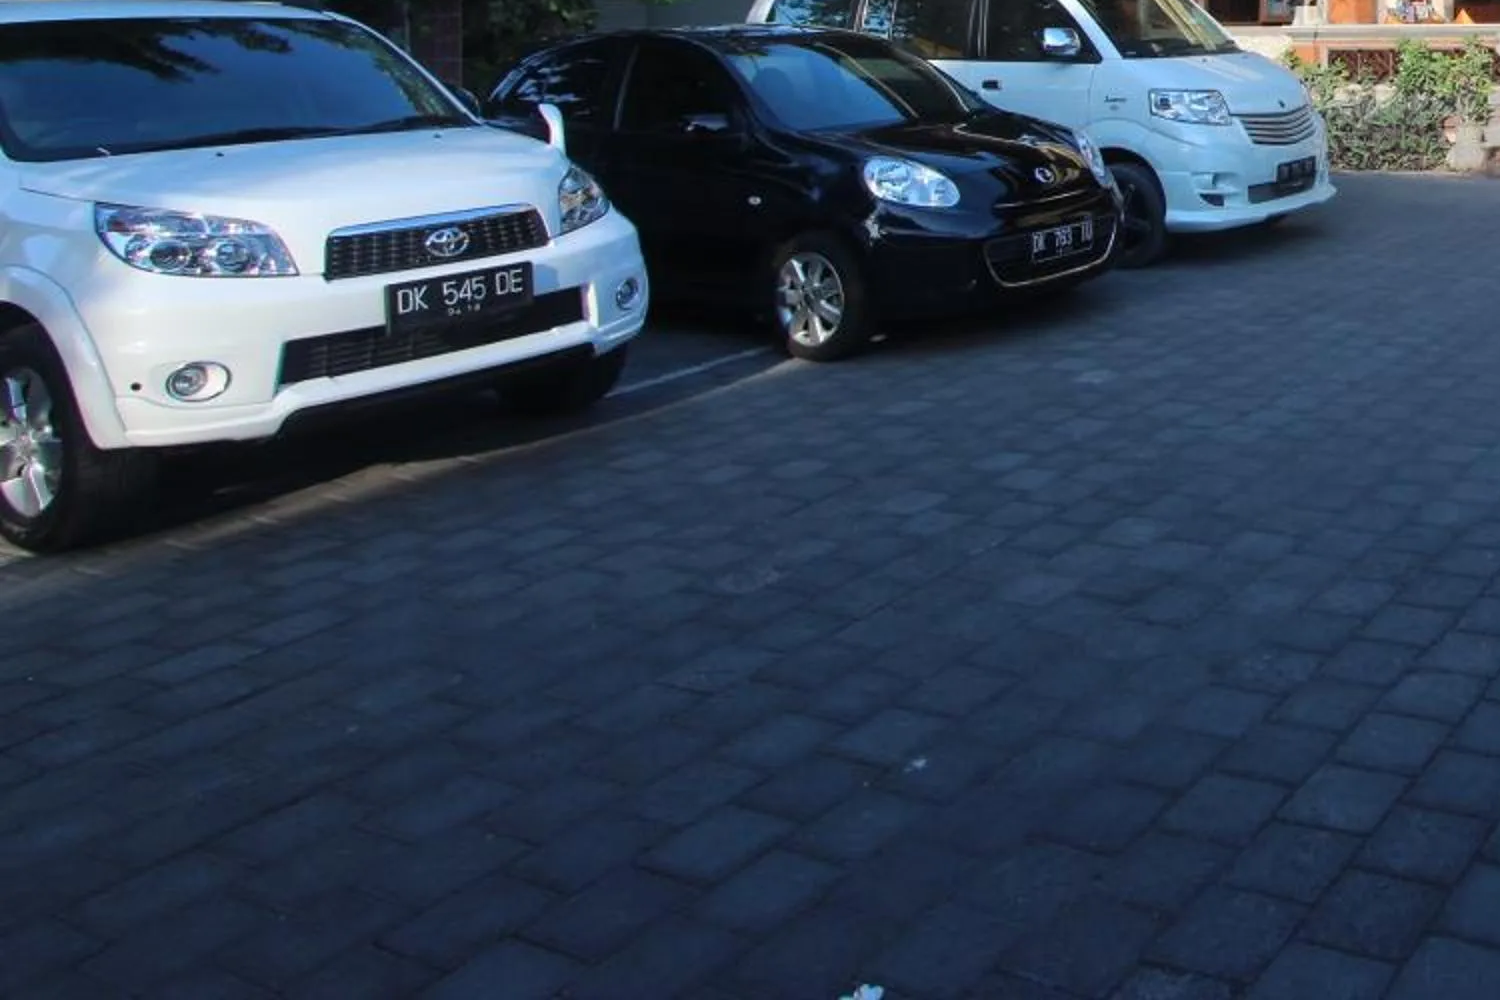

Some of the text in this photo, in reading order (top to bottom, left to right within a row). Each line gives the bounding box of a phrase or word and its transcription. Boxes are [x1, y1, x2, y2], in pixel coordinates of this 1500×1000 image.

[397, 268, 523, 314] DK 545 DE
